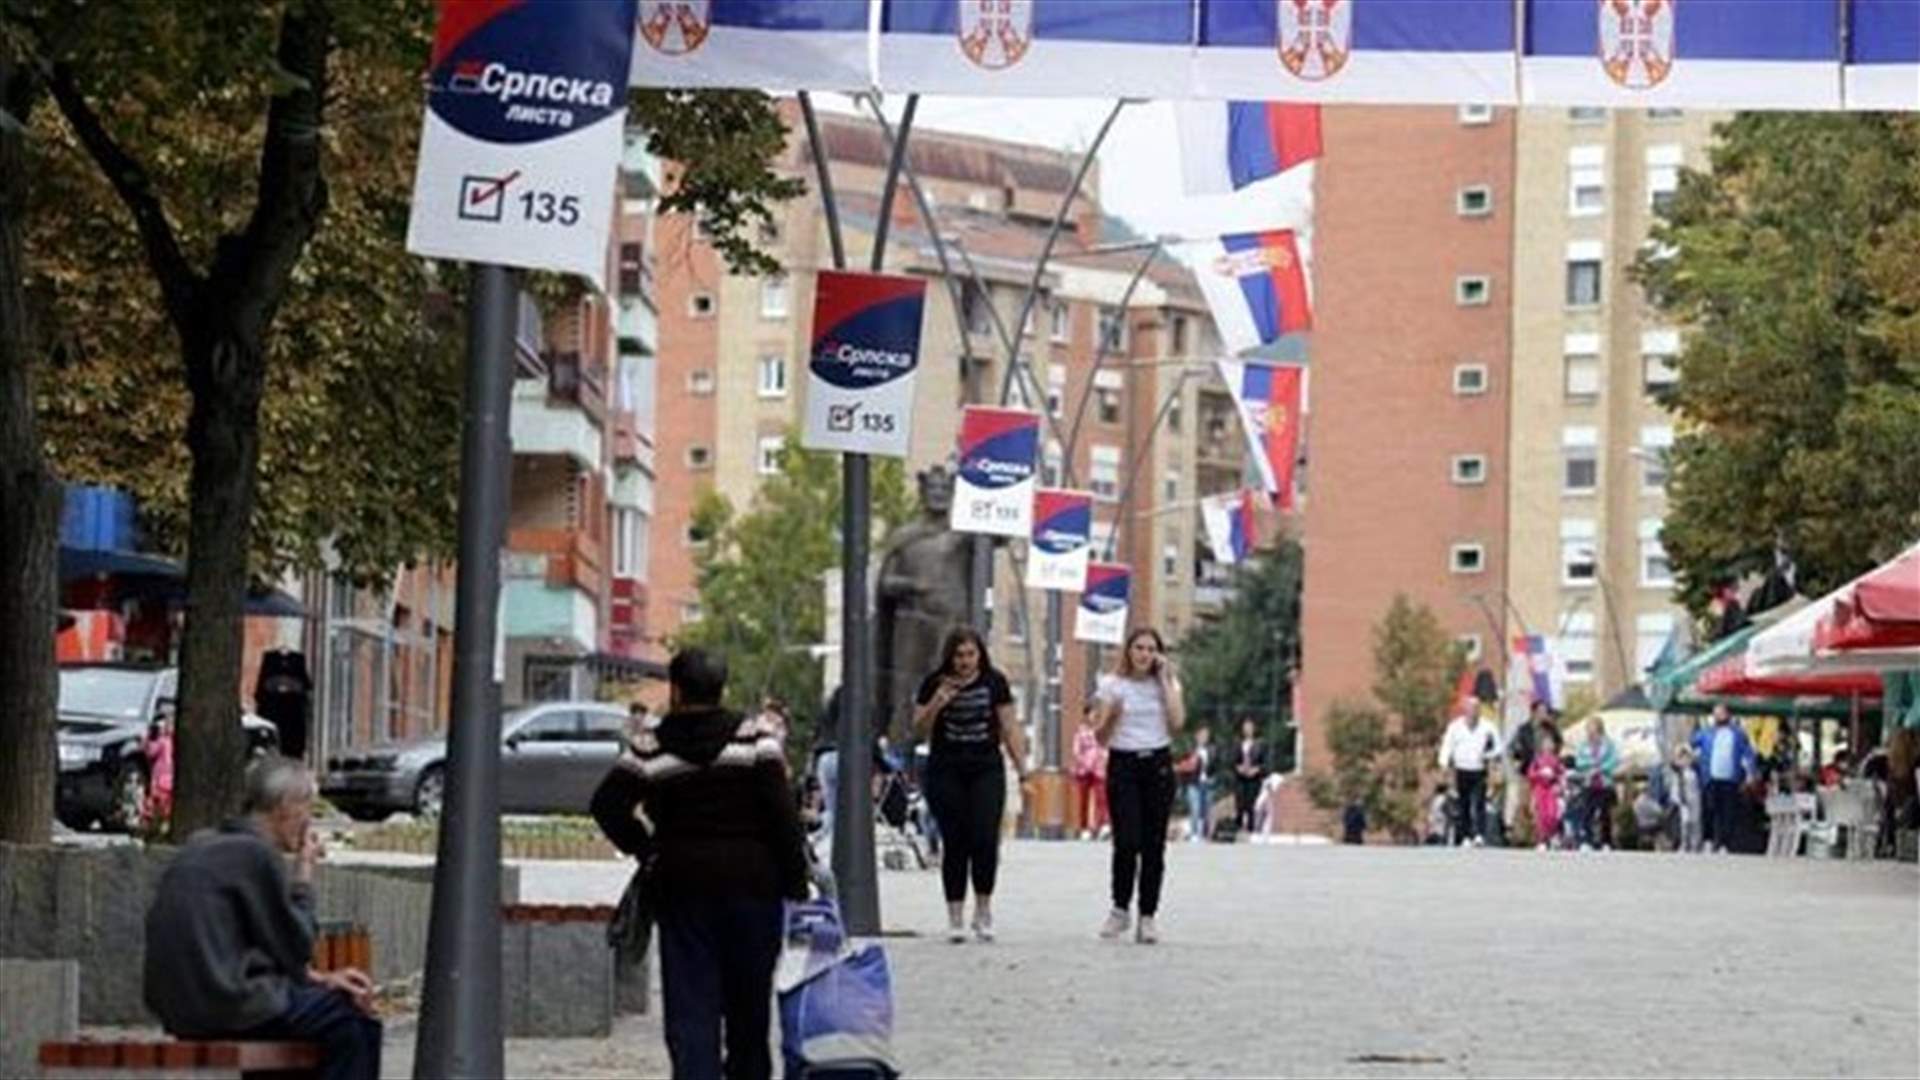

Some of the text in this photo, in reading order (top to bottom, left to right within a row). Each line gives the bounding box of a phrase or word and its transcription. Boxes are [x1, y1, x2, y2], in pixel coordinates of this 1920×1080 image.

[480, 62, 614, 106] Српска
[505, 104, 574, 127] листа
[519, 190, 581, 226] 135
[837, 344, 912, 368] Српска
[863, 412, 895, 433] 135
